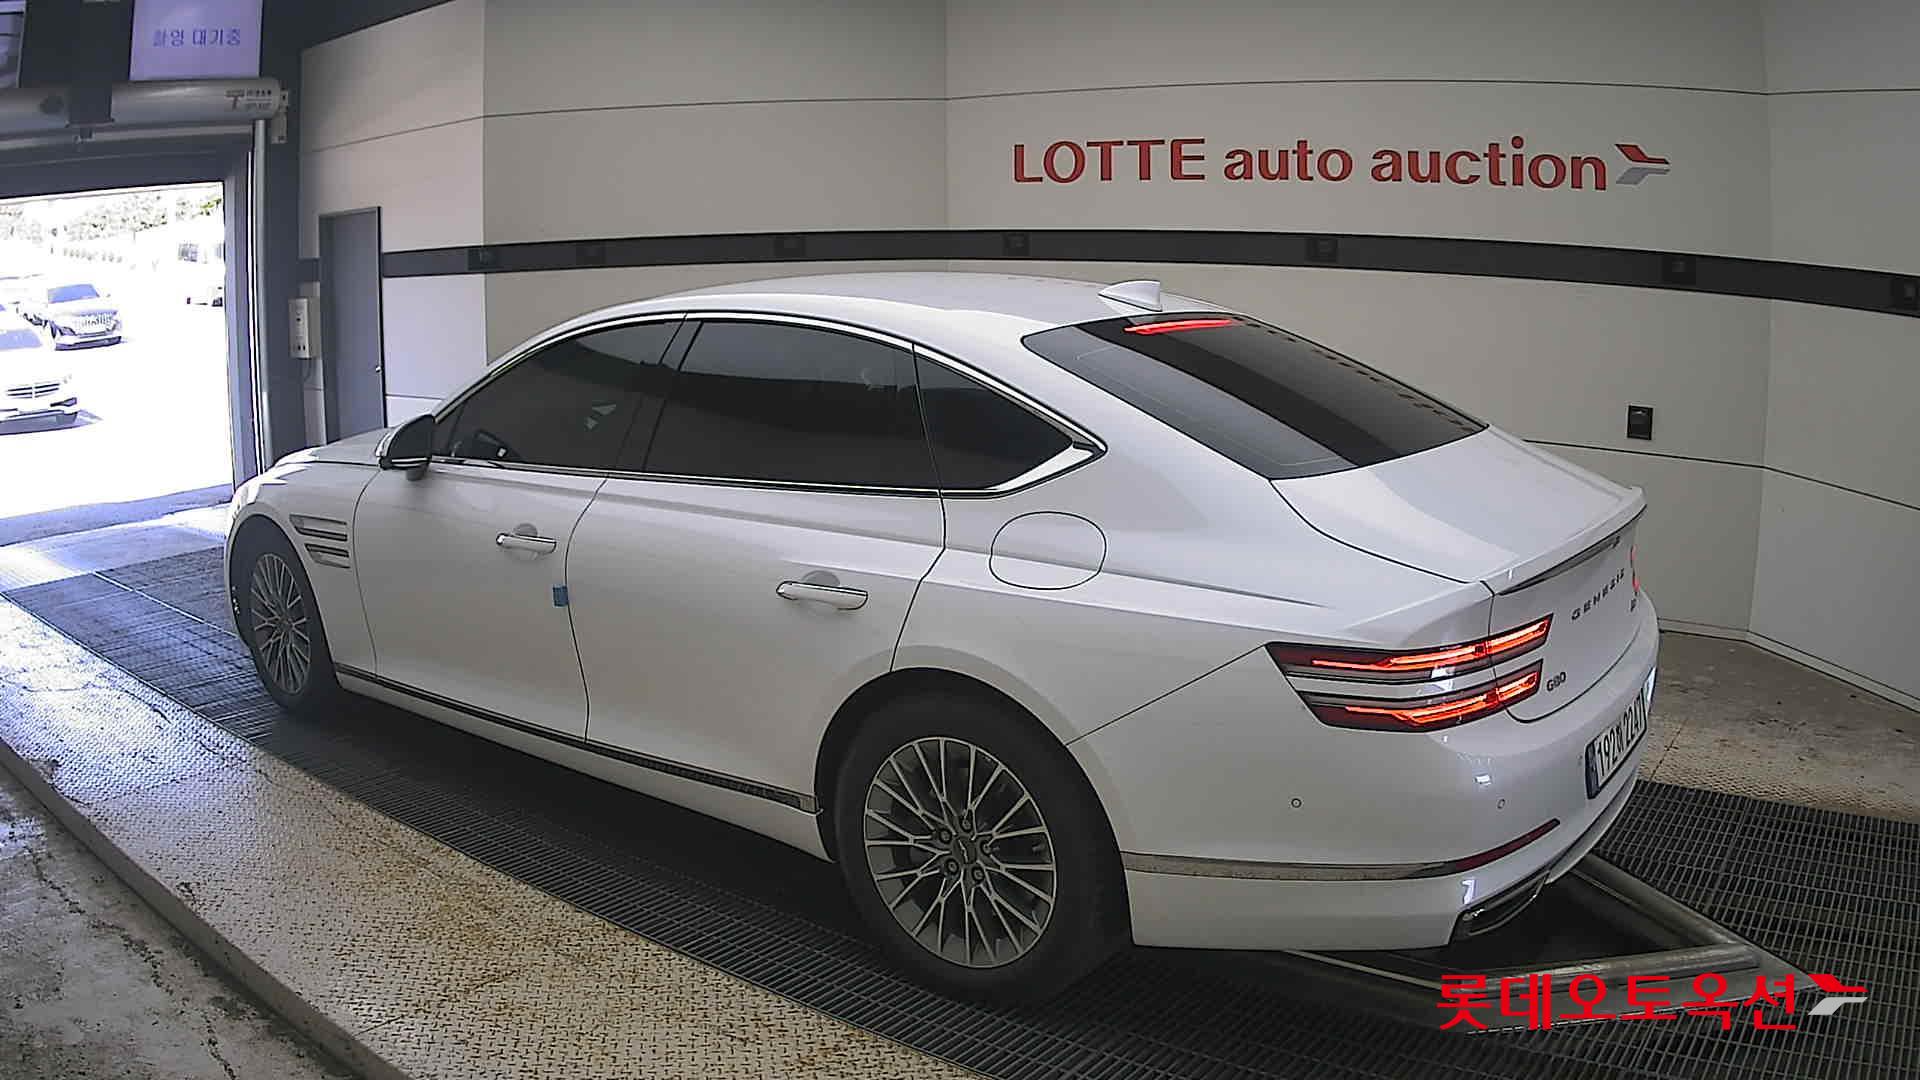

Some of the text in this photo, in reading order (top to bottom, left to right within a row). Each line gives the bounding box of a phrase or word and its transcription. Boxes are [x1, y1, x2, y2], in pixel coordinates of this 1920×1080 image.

[1013, 135, 1607, 191] LOTTE auto auction
[1546, 671, 1567, 691] G80
